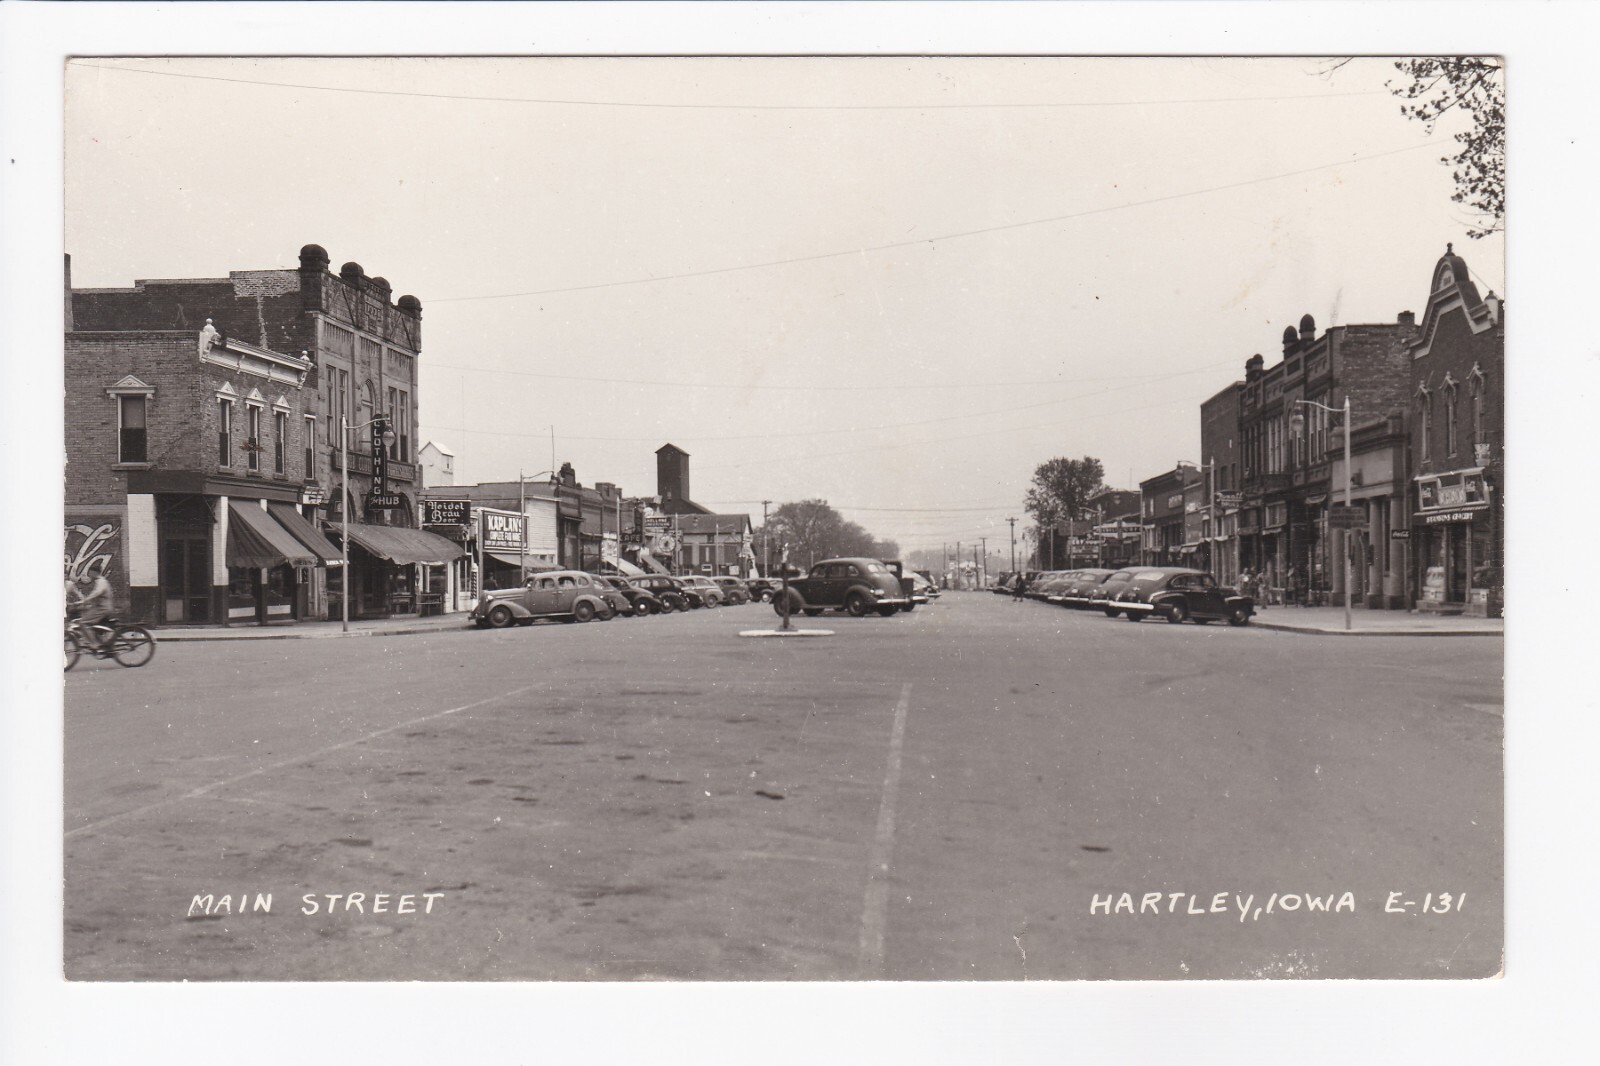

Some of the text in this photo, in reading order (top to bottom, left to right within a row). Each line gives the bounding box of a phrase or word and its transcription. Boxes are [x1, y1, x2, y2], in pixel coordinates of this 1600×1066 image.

[373, 418, 382, 495] CLOTHING
[378, 496, 400, 505] HUB
[427, 501, 465, 510] Heidel
